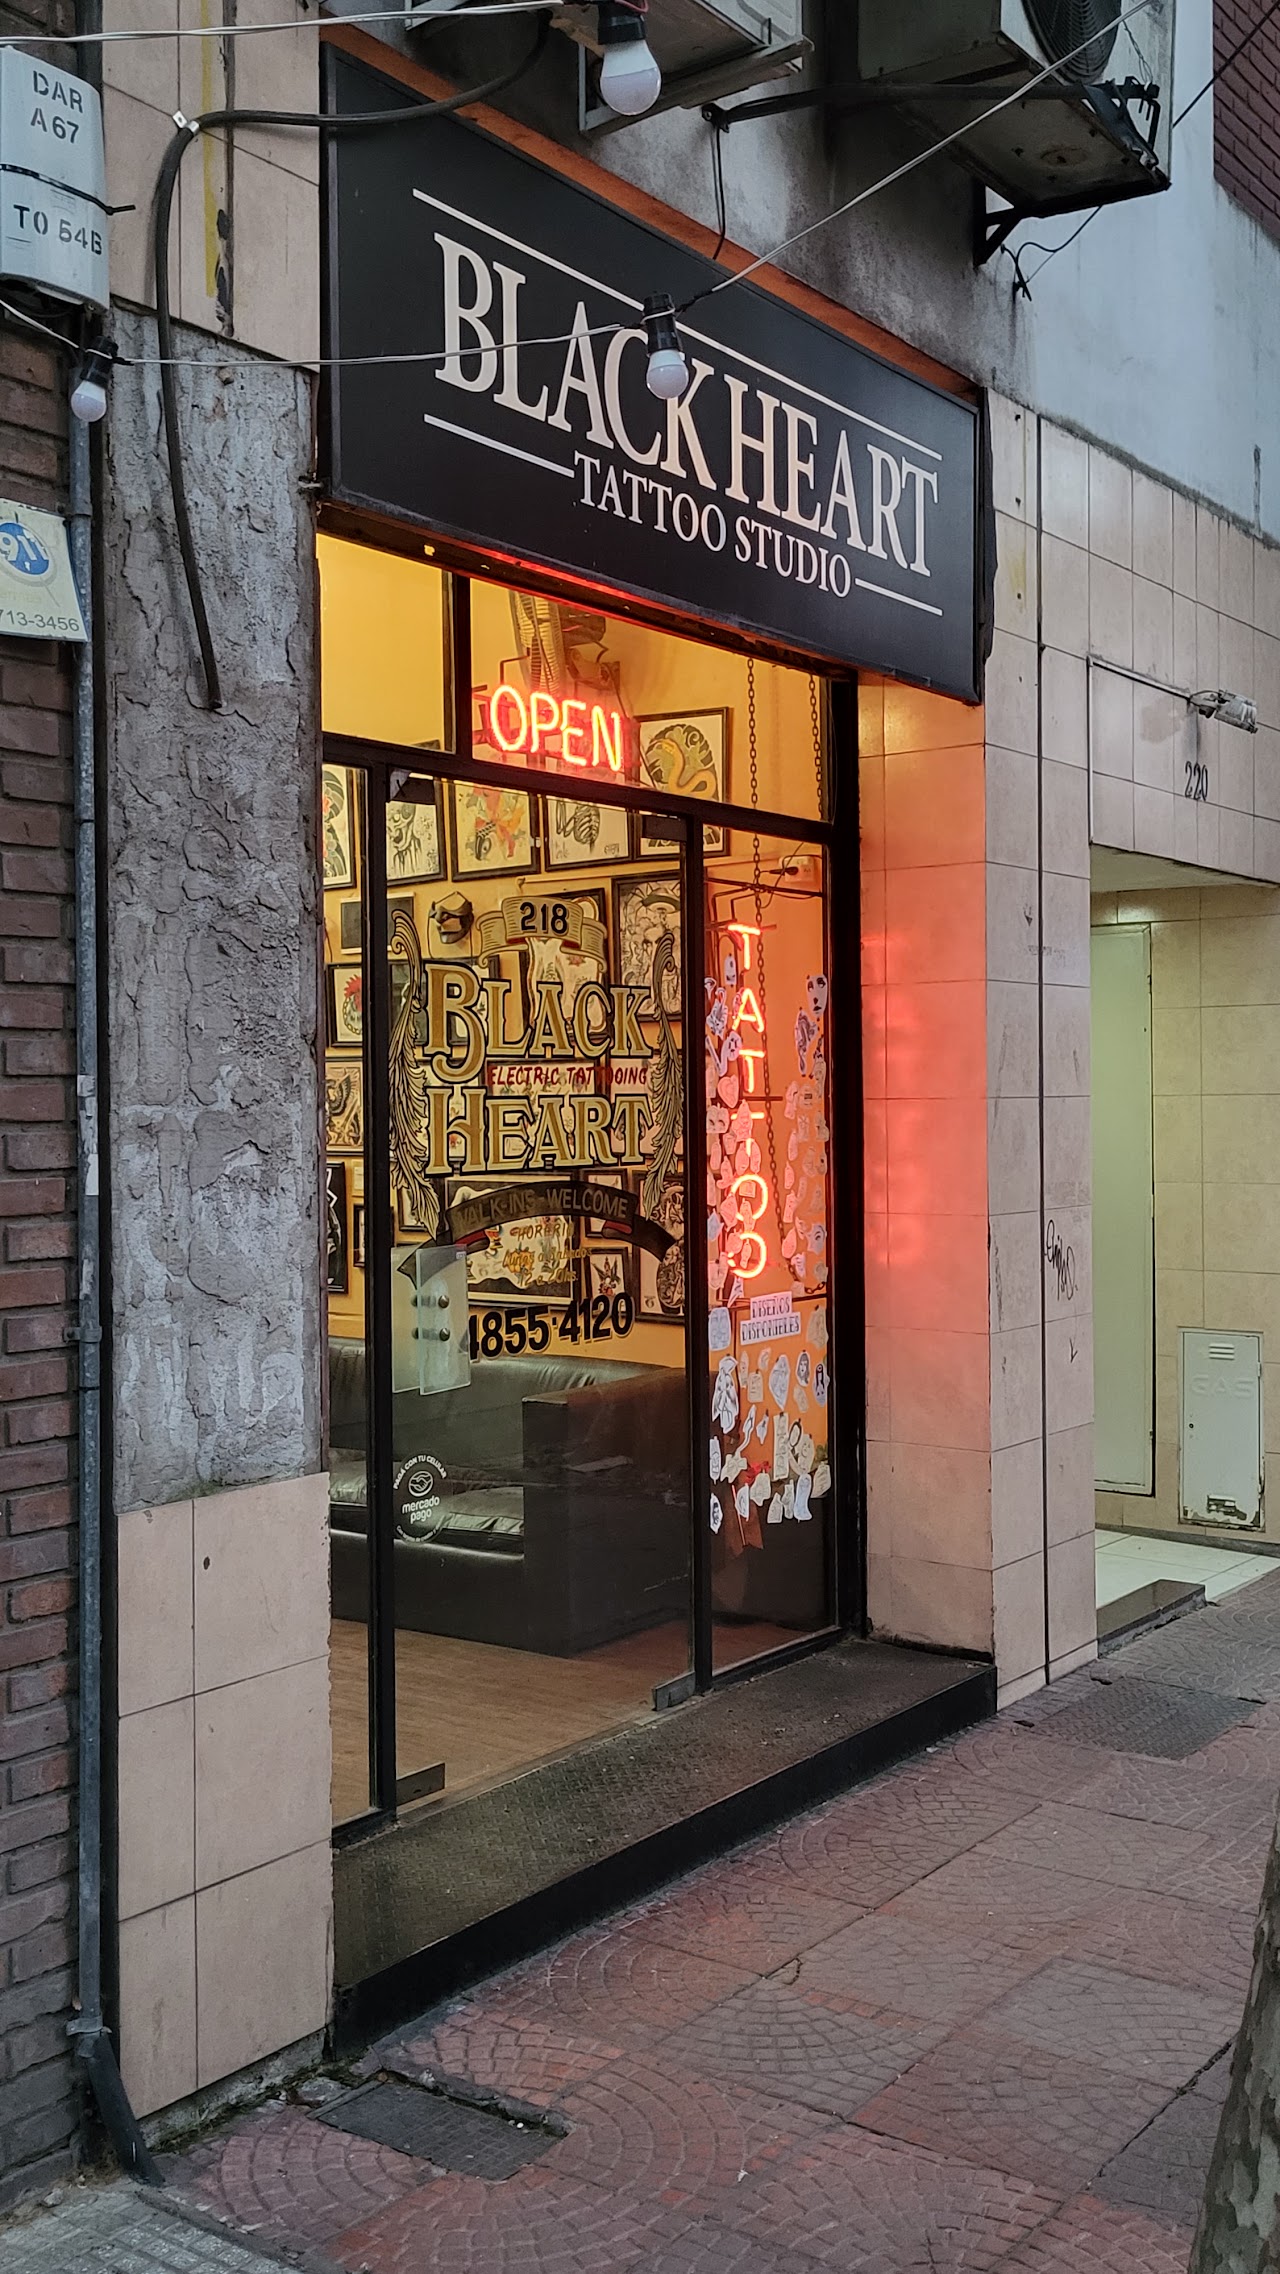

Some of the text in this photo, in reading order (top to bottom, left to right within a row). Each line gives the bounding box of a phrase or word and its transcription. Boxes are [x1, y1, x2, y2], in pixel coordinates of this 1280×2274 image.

[33, 70, 83, 113] DAR
[574, 450, 852, 598] TATTOO STUDIO
[489, 684, 622, 772] OPEN
[1185, 761, 1208, 801] 220
[520, 901, 568, 935] 218
[423, 961, 653, 1084] BLACK
[489, 1066, 560, 1086] ELECTRIC
[424, 1086, 653, 1176] HEART
[402, 1495, 440, 1514] mercado
[410, 1508, 432, 1524] pago
